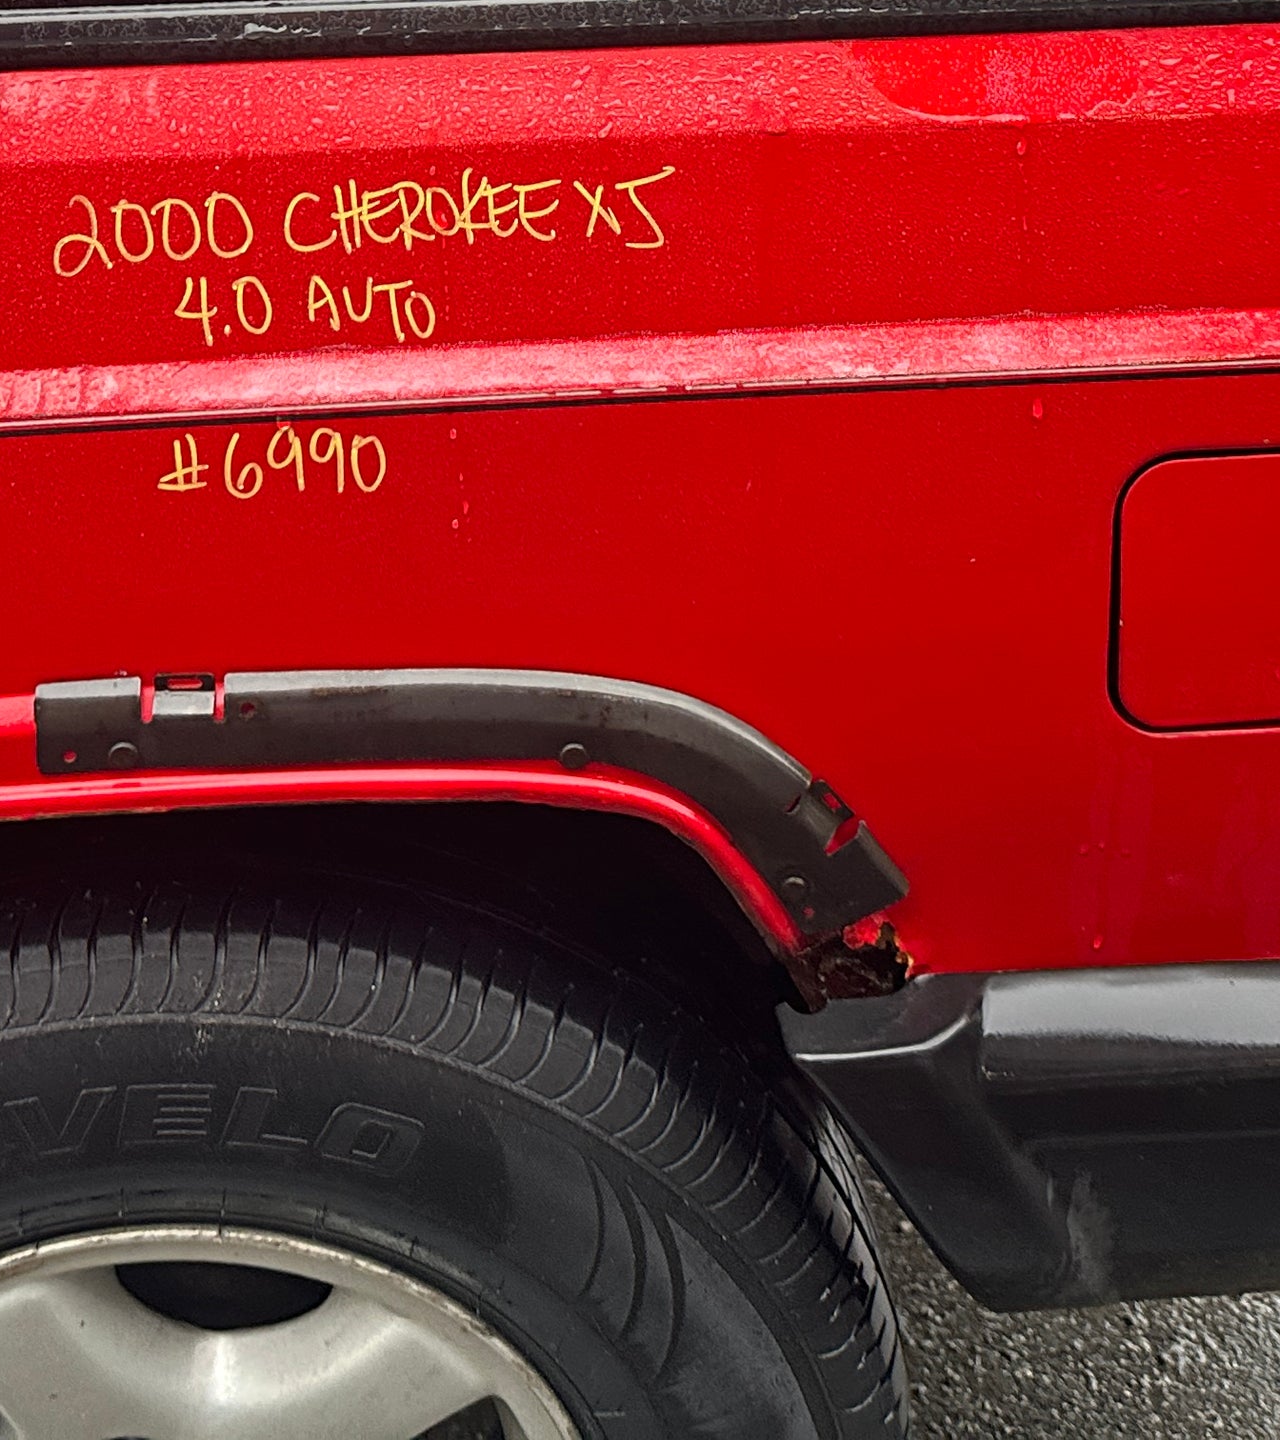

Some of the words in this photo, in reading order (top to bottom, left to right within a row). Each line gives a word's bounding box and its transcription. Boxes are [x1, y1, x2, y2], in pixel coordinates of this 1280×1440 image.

[53, 192, 254, 278] 2000
[283, 167, 561, 253] CHEROKEE
[573, 166, 675, 249] XJ
[174, 275, 273, 346] 4.0
[307, 275, 436, 341] AUTO
[158, 426, 388, 500] #6990
